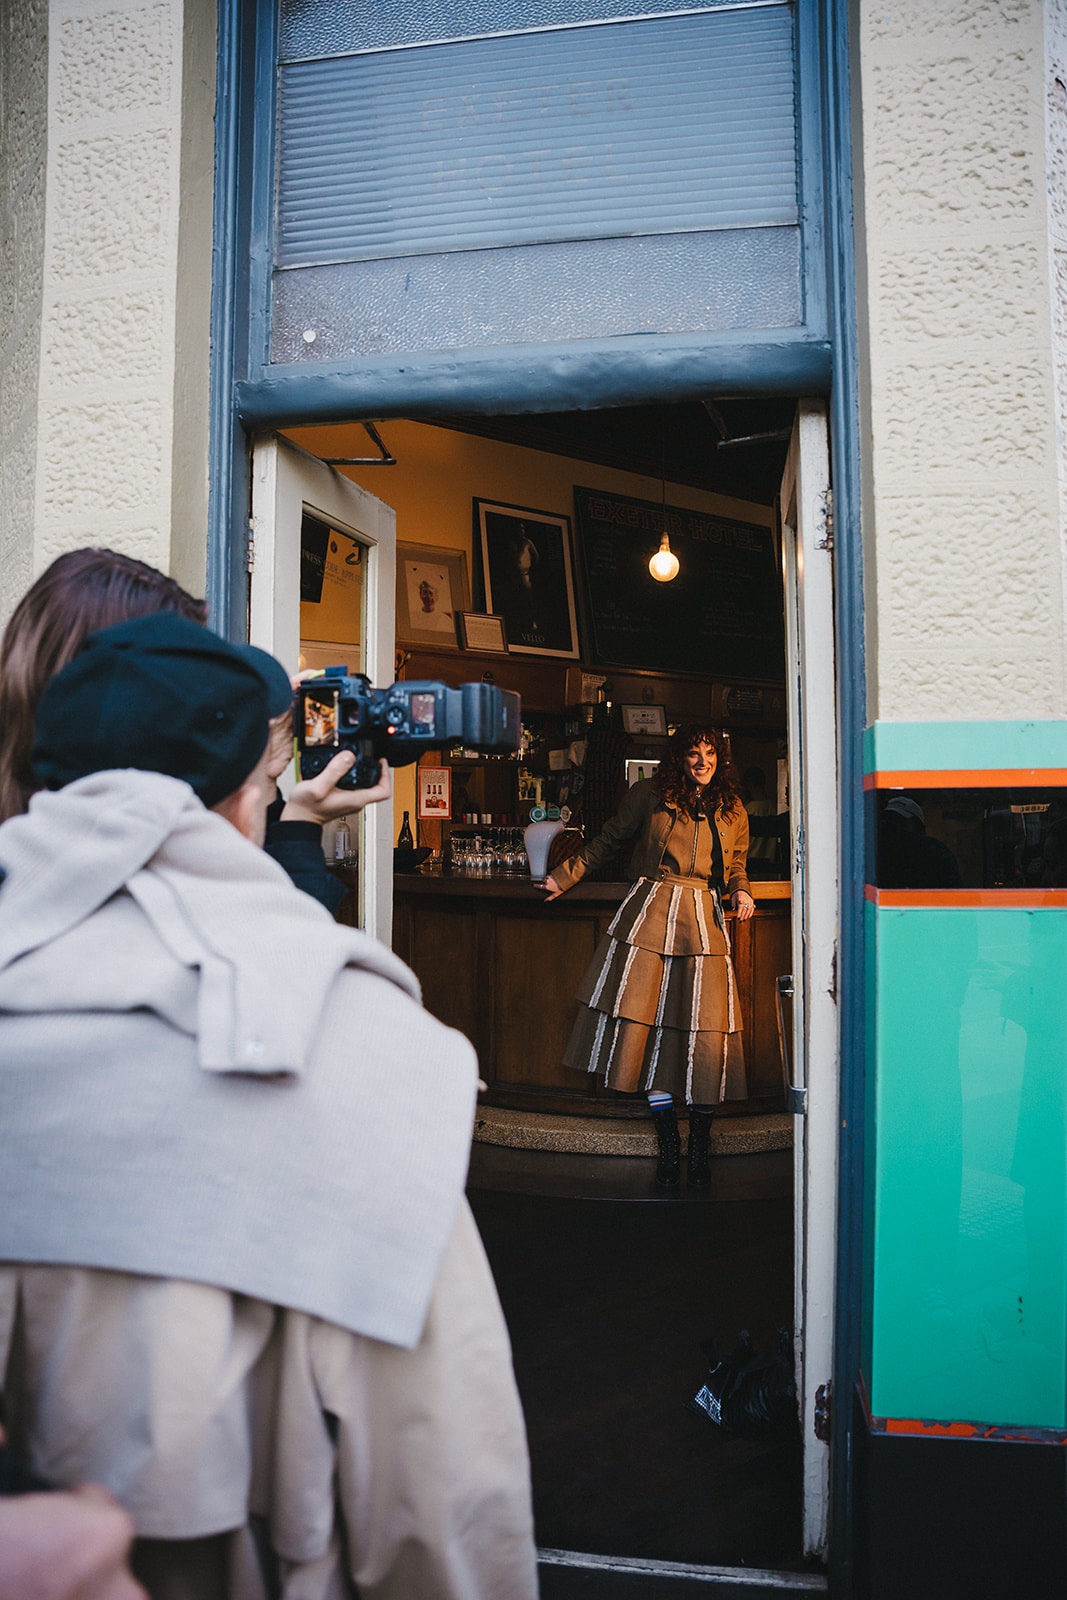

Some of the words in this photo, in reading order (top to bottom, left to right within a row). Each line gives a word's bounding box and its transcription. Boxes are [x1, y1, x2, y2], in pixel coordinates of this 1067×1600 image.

[420, 79, 636, 131] EXETER
[432, 144, 630, 195] HOTEL
[587, 496, 684, 536] EXETER
[688, 517, 762, 551] HOTEL
